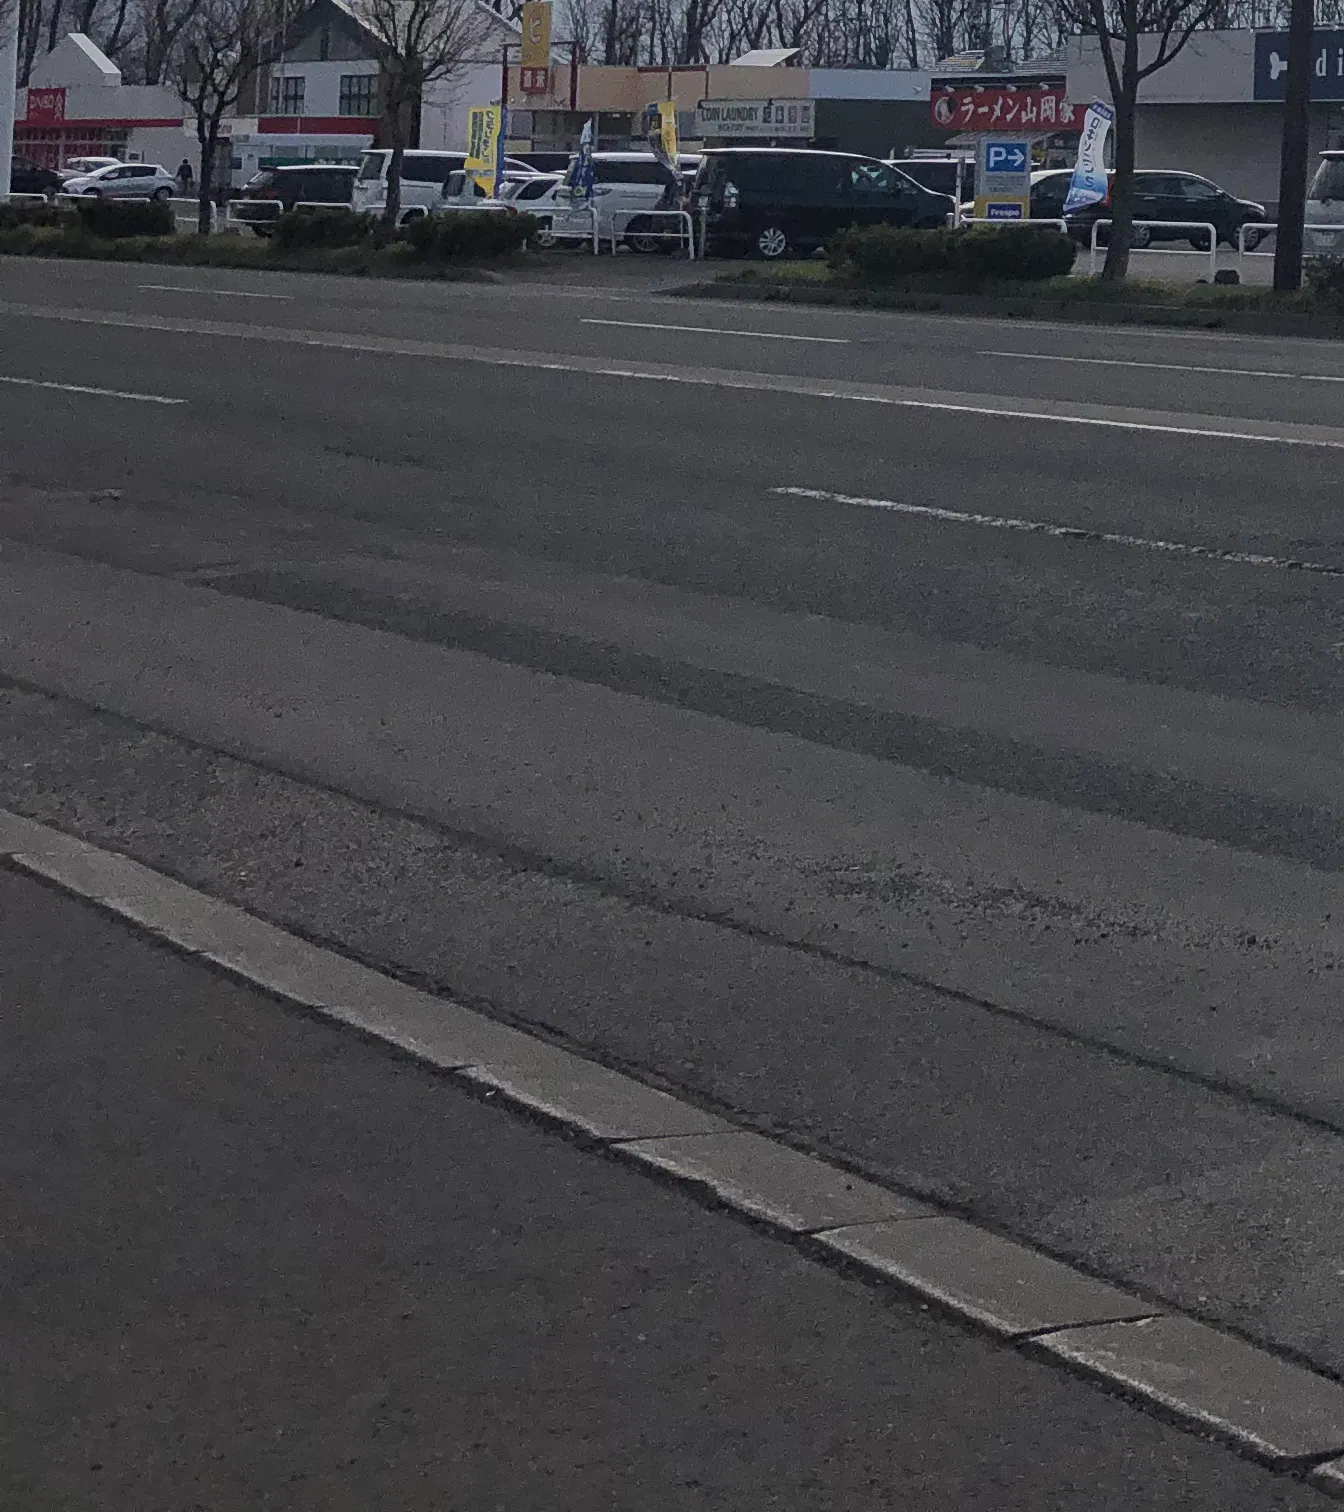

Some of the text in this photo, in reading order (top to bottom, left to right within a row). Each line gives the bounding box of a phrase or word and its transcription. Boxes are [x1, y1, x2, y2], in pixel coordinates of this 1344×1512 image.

[961, 95, 1076, 124] ラーメン山岡家
[989, 147, 1007, 168] P
